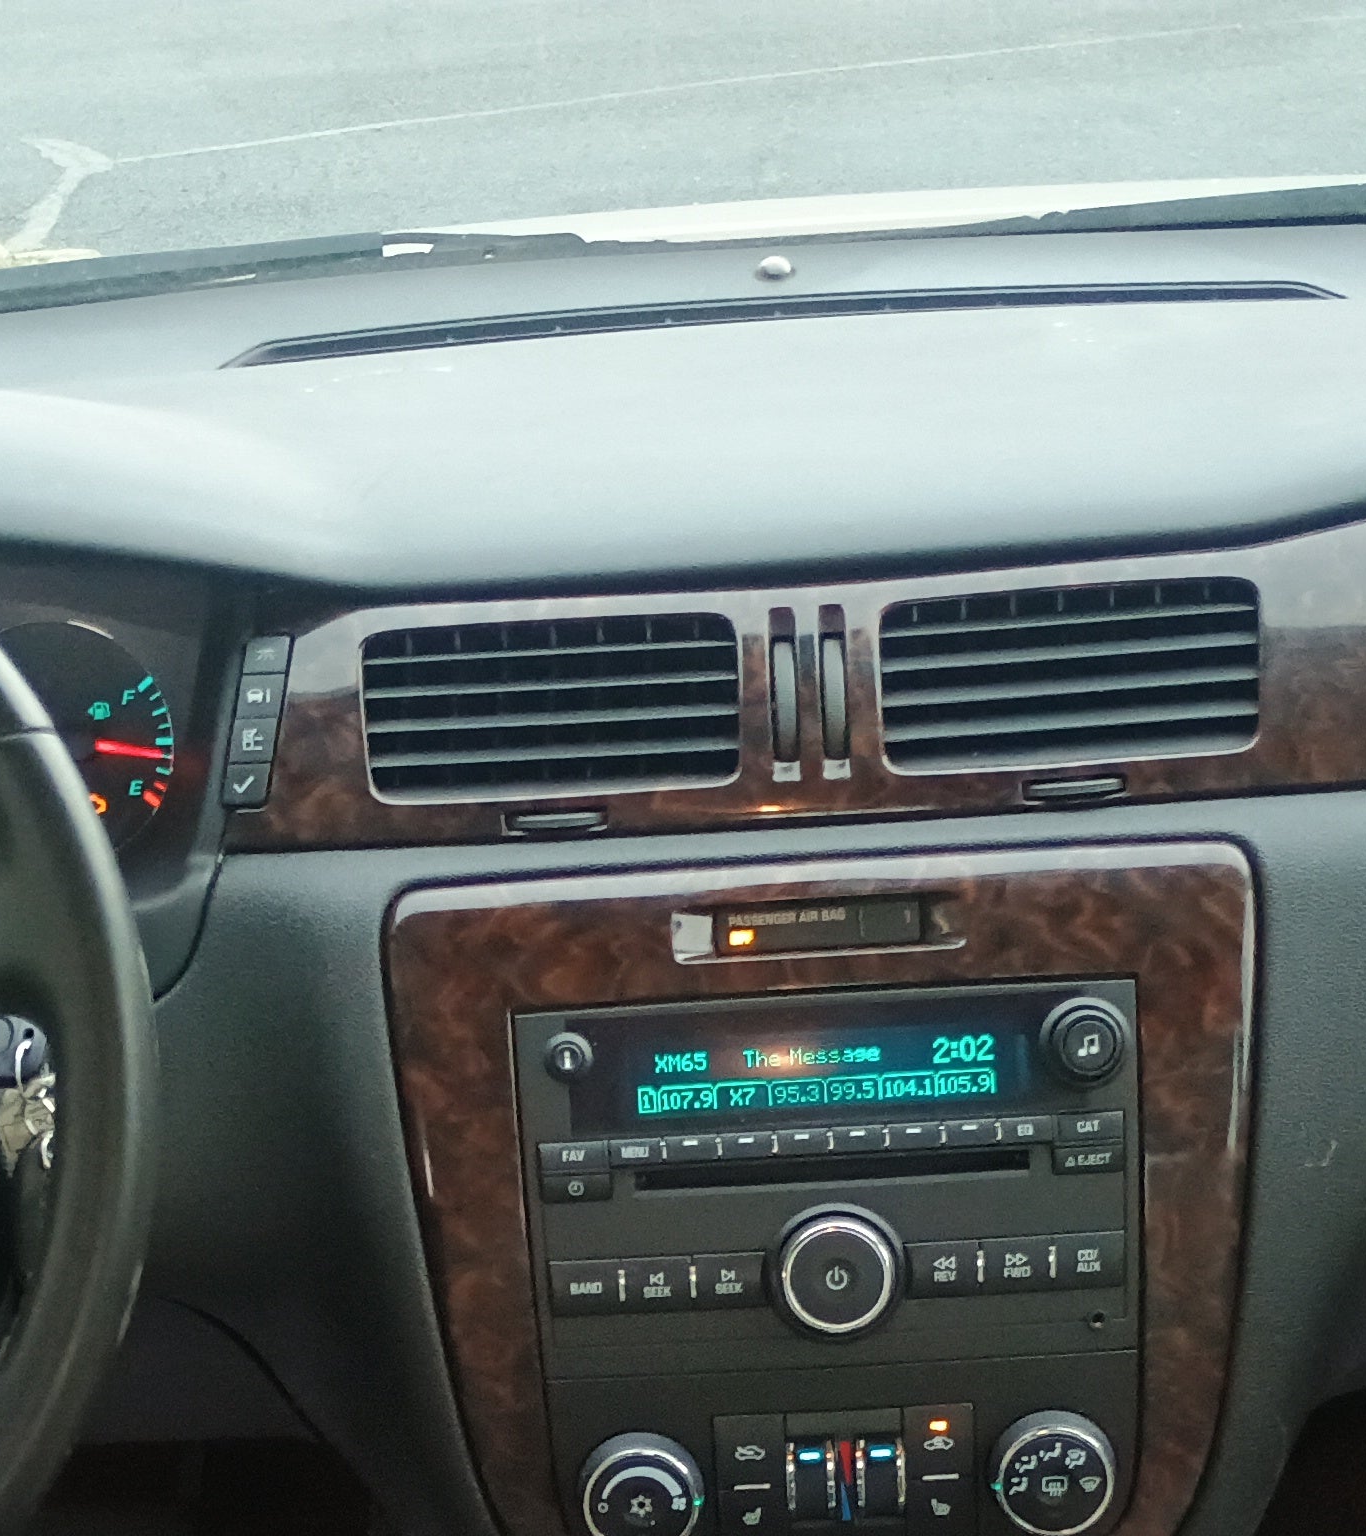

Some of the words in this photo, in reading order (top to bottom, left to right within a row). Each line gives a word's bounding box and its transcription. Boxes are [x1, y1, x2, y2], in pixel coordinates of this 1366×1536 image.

[121, 688, 136, 705] F
[129, 779, 143, 796] E
[655, 1051, 708, 1074] XM65
[743, 1047, 782, 1068] The
[932, 1033, 996, 1064] 2:02
[661, 1089, 713, 1112] 107.9
[730, 1087, 756, 1107] X7
[774, 1084, 820, 1104] 95.3
[830, 1080, 876, 1101] 99.5
[884, 1078, 934, 1099] 104.1
[938, 1074, 992, 1096] 105.9
[561, 1149, 587, 1163] FAV
[1077, 1151, 1113, 1166] EJECT
